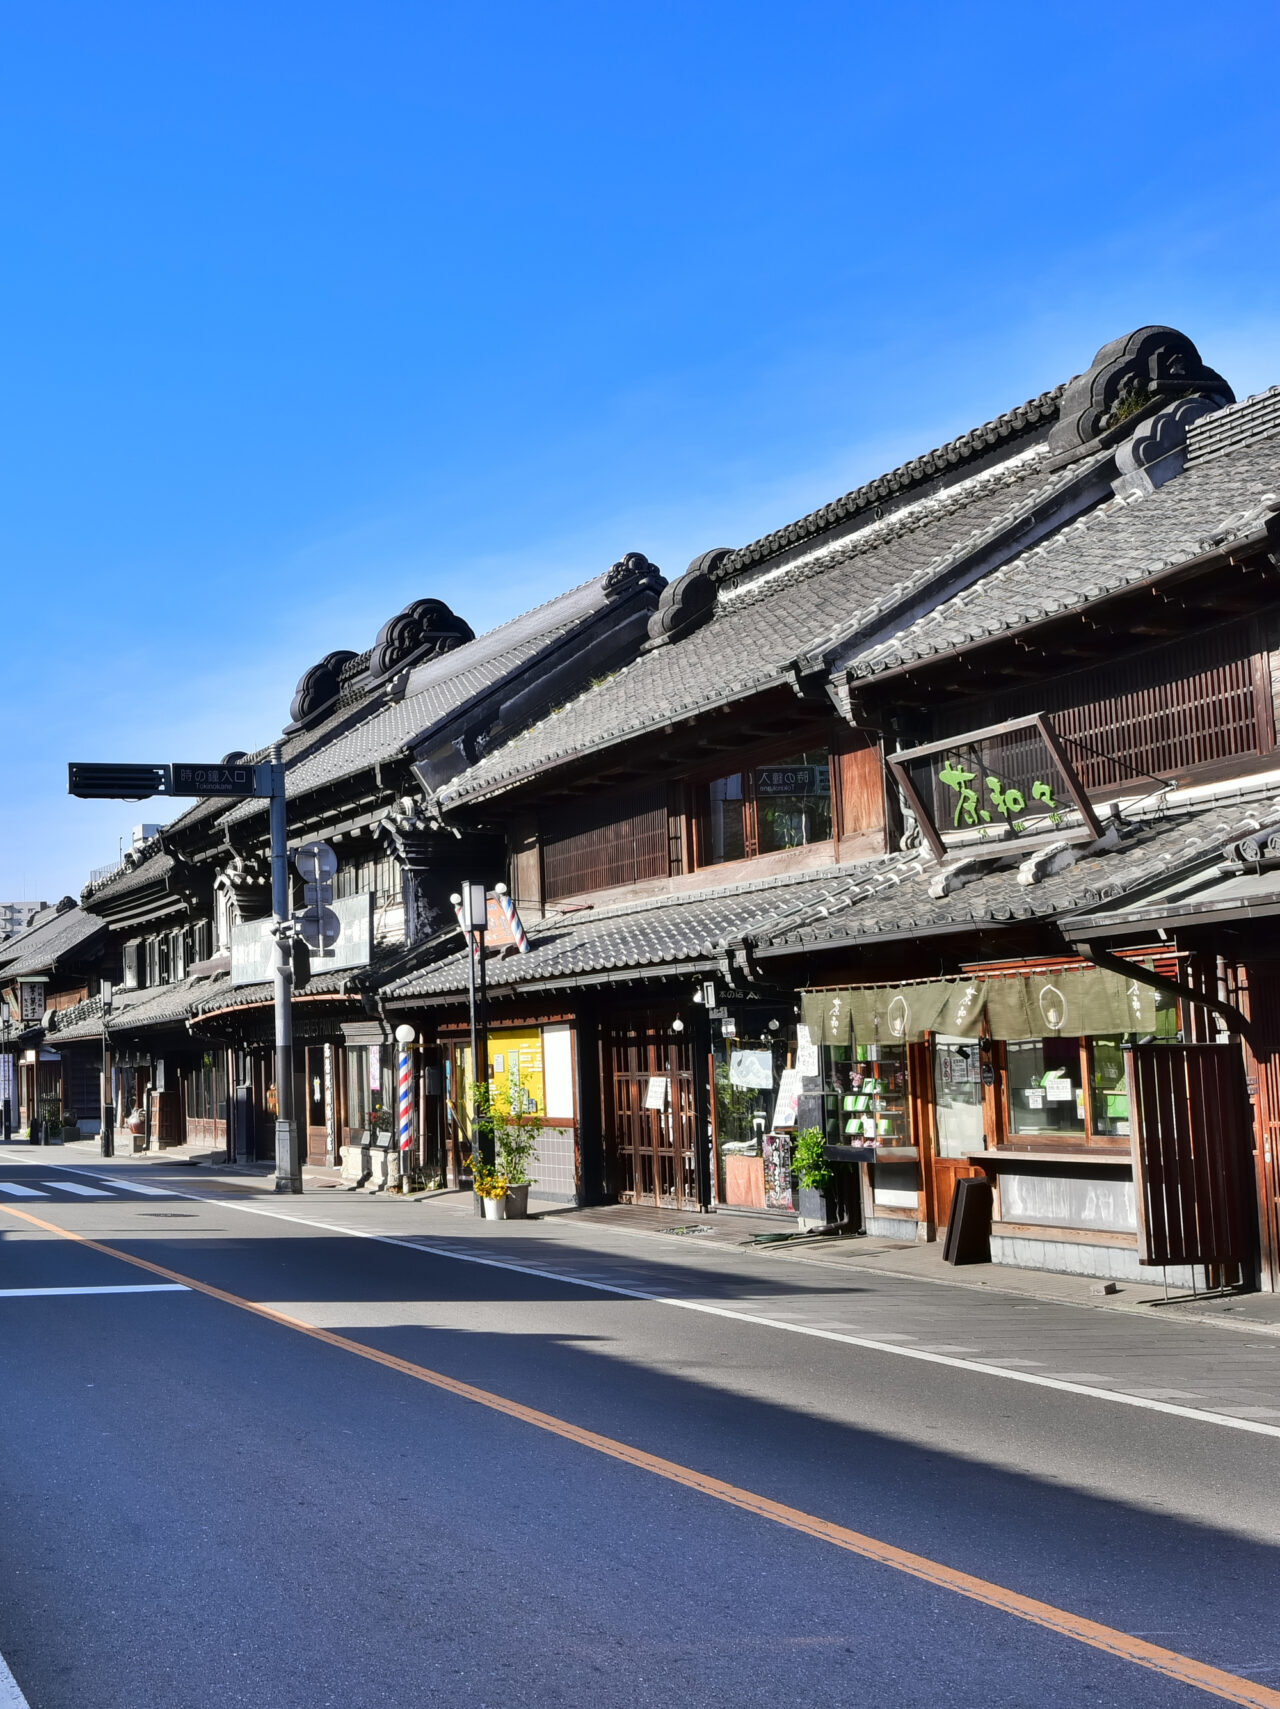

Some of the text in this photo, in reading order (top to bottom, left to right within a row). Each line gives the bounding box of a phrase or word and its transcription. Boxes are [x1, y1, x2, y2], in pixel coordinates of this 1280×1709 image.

[180, 768, 246, 782] 時の鐘入口
[196, 782, 232, 790] Tokinokane
